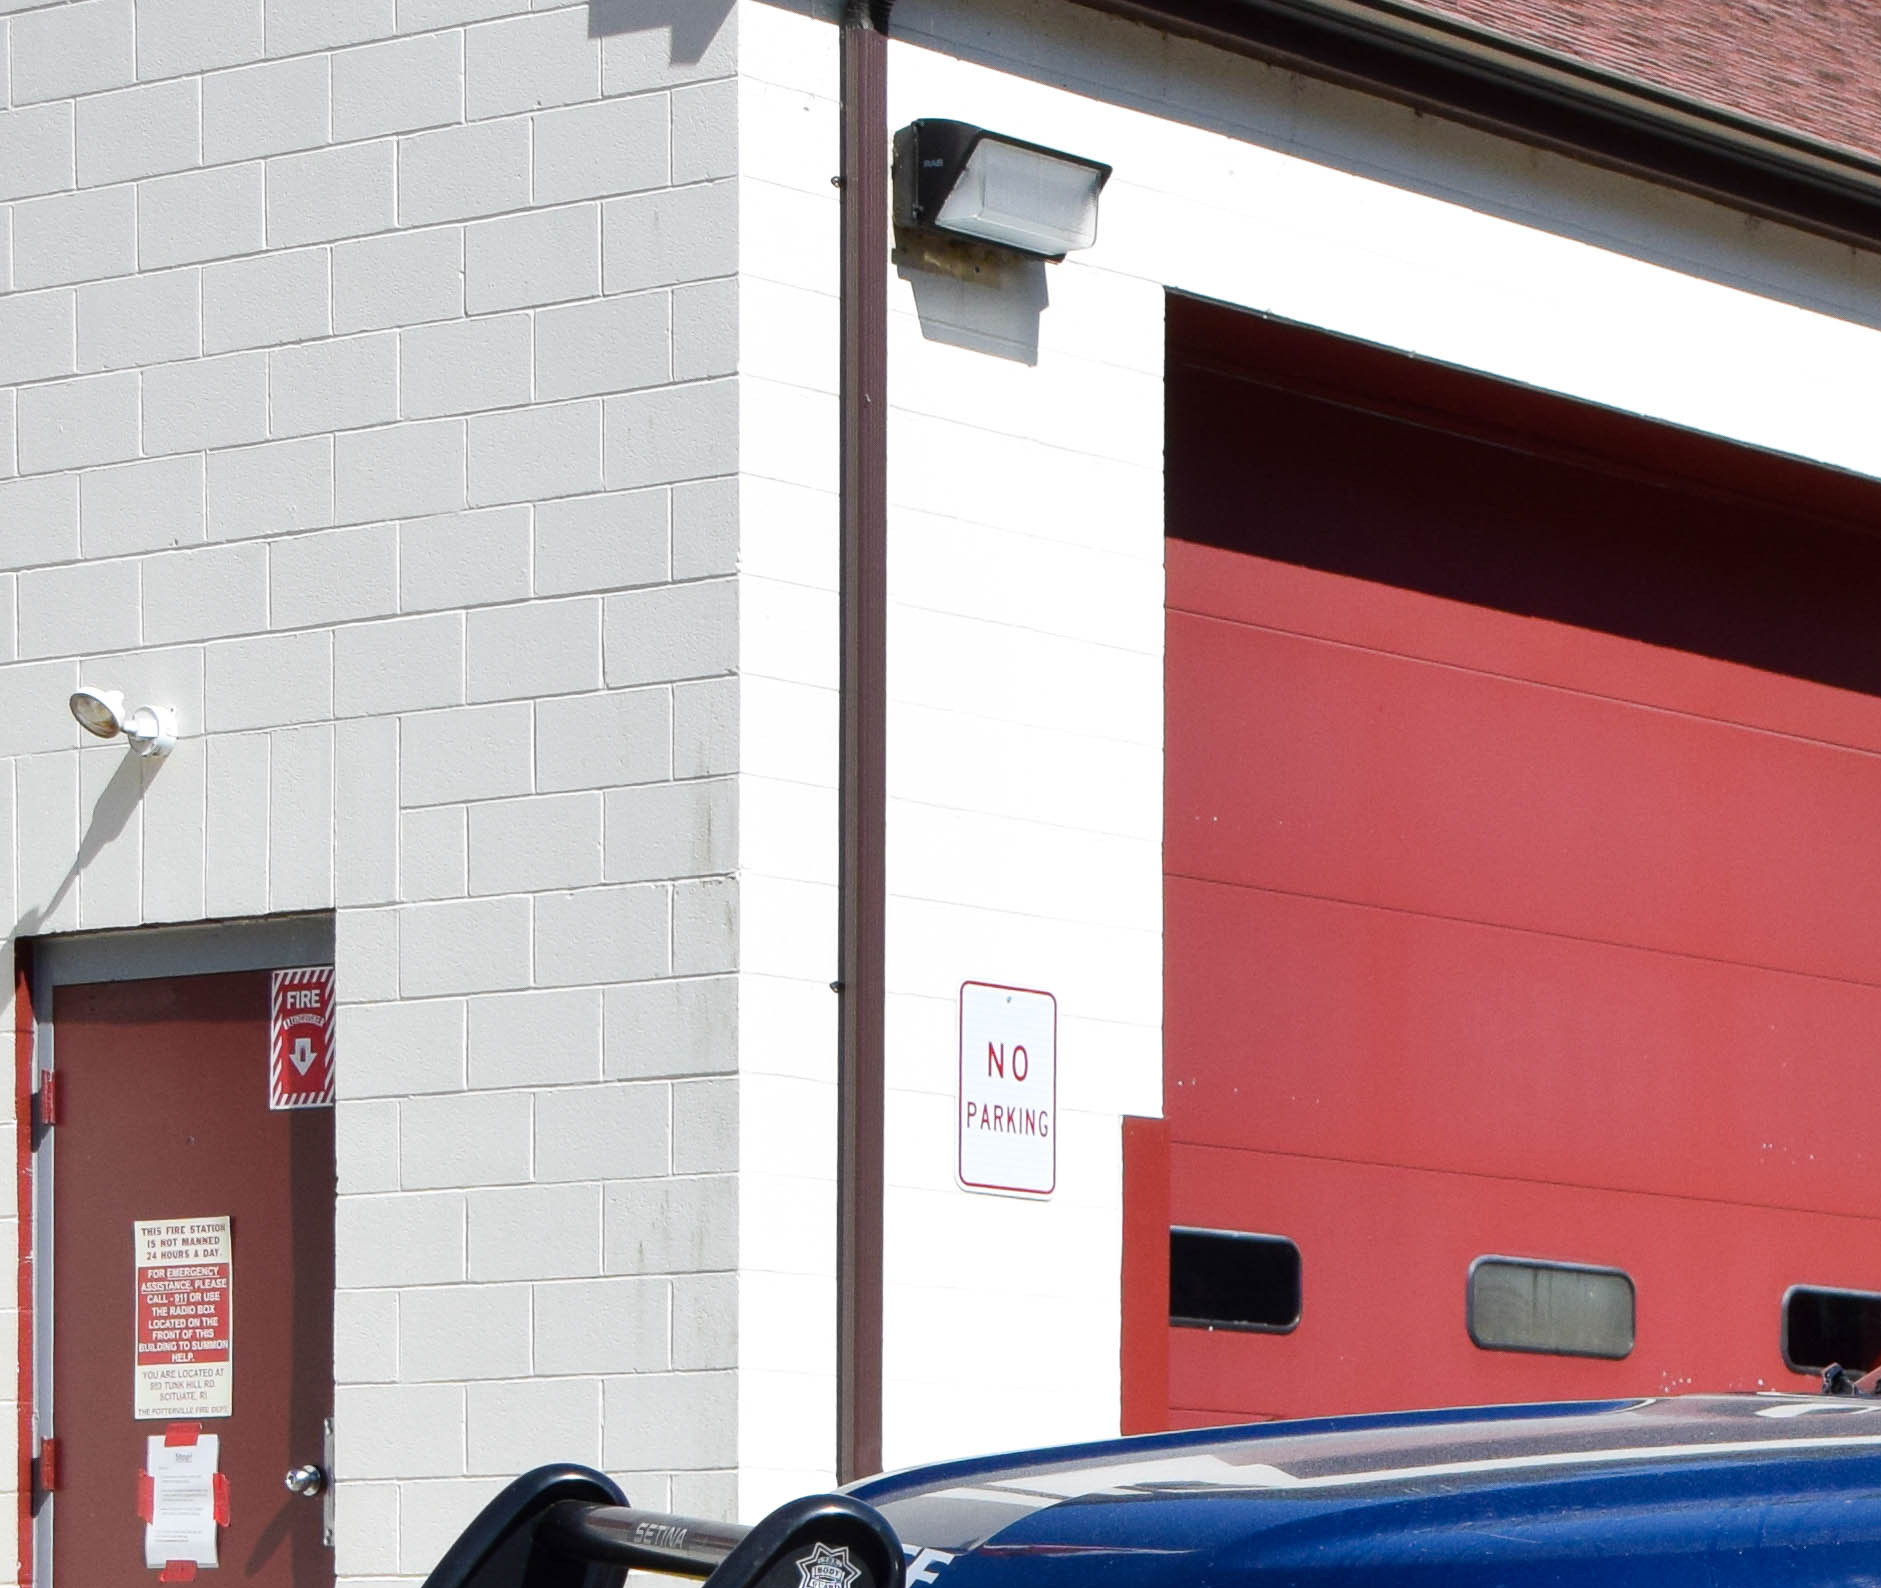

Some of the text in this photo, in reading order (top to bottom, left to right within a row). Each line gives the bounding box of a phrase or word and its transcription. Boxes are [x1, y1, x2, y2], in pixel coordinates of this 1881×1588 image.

[286, 989, 320, 1009] FIRE
[988, 1041, 1028, 1082] NO
[966, 1101, 1049, 1138] PARKING
[141, 1223, 226, 1237] THIS FIRE STATION
[147, 1236, 220, 1249] IS NOT MANNED
[146, 1251, 157, 1261] 24
[161, 1249, 190, 1260] HOURS
[193, 1250, 200, 1258] A
[147, 1266, 219, 1279] FOR EMERGENCY
[194, 1278, 228, 1289] PLEASE
[146, 1294, 168, 1304] CALL
[174, 1293, 188, 1305] 911
[189, 1292, 202, 1302] OR
[204, 1291, 221, 1302] USE
[152, 1304, 215, 1317] THE RADIO BOX
[148, 1317, 219, 1329] LOCATED ON THE
[152, 1328, 215, 1341] FRONT OF THIS
[138, 1339, 229, 1353] BUILDING TO SUMMON
[171, 1352, 196, 1363] HELP.
[142, 1367, 225, 1380] YOU ARE LOCATED AT
[186, 1380, 203, 1390] HILL
[138, 1408, 150, 1416] THE
[152, 1406, 194, 1416] POTTERVILLE
[195, 1405, 210, 1414] FIRE
[634, 1522, 688, 1550] SETINA
